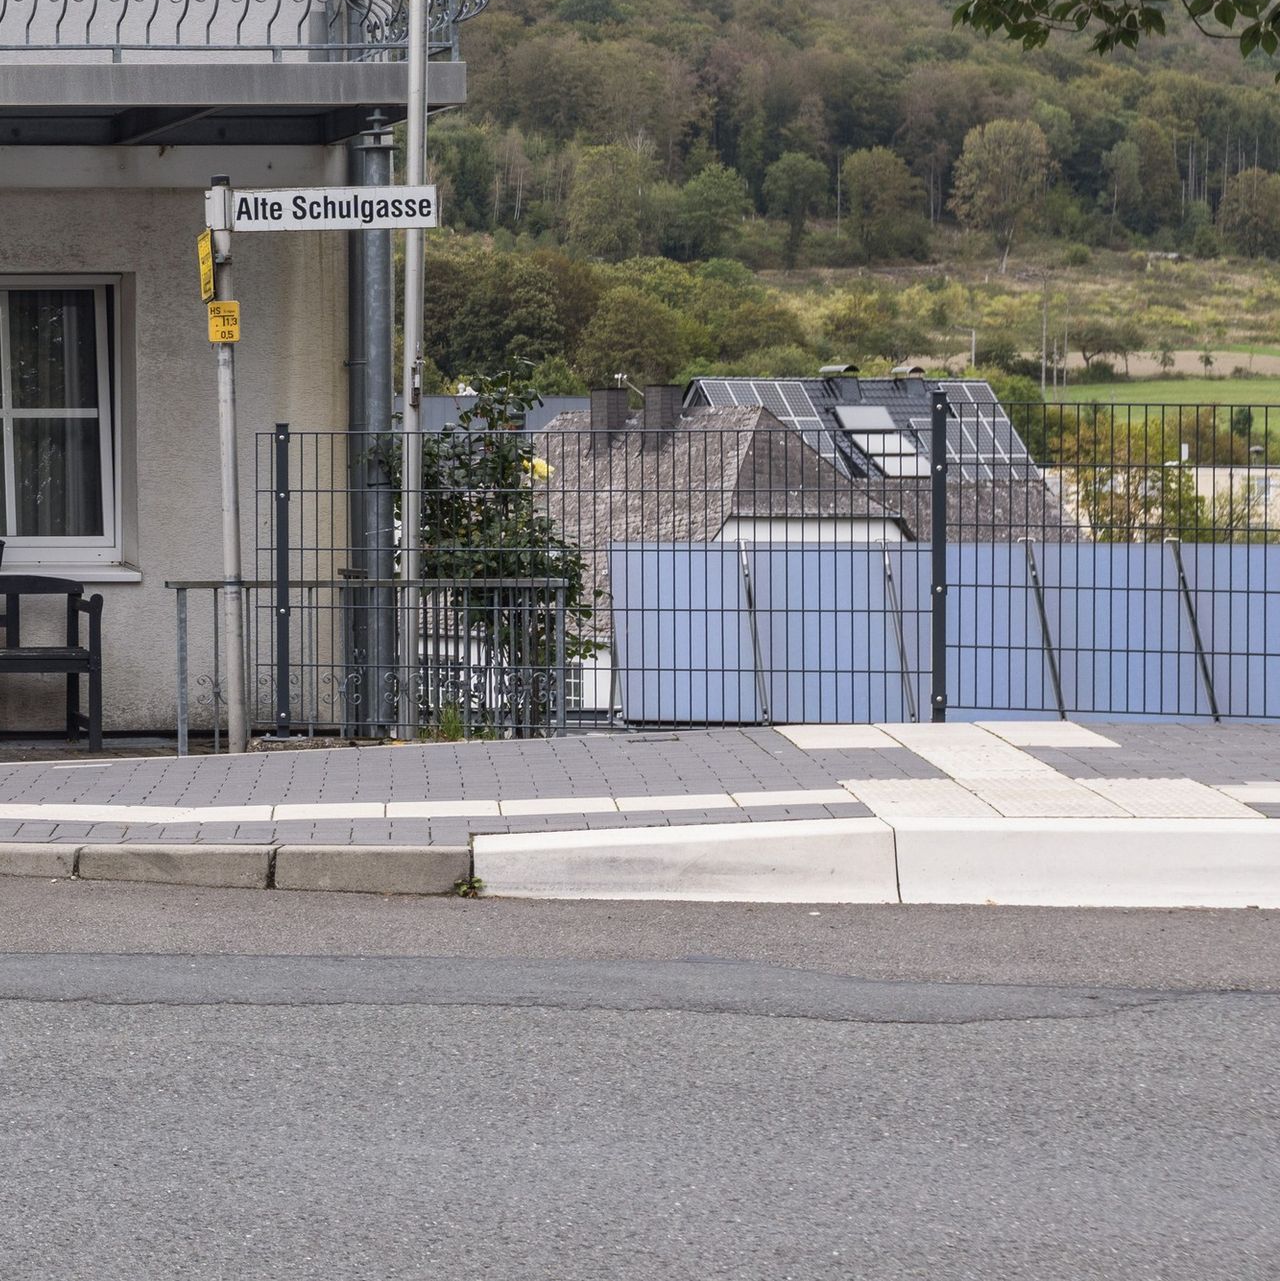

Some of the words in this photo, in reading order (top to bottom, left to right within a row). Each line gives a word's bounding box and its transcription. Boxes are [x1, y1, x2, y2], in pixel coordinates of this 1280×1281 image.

[236, 196, 283, 221] Alte
[292, 194, 432, 224] Schulgasse
[210, 306, 221, 315] HS
